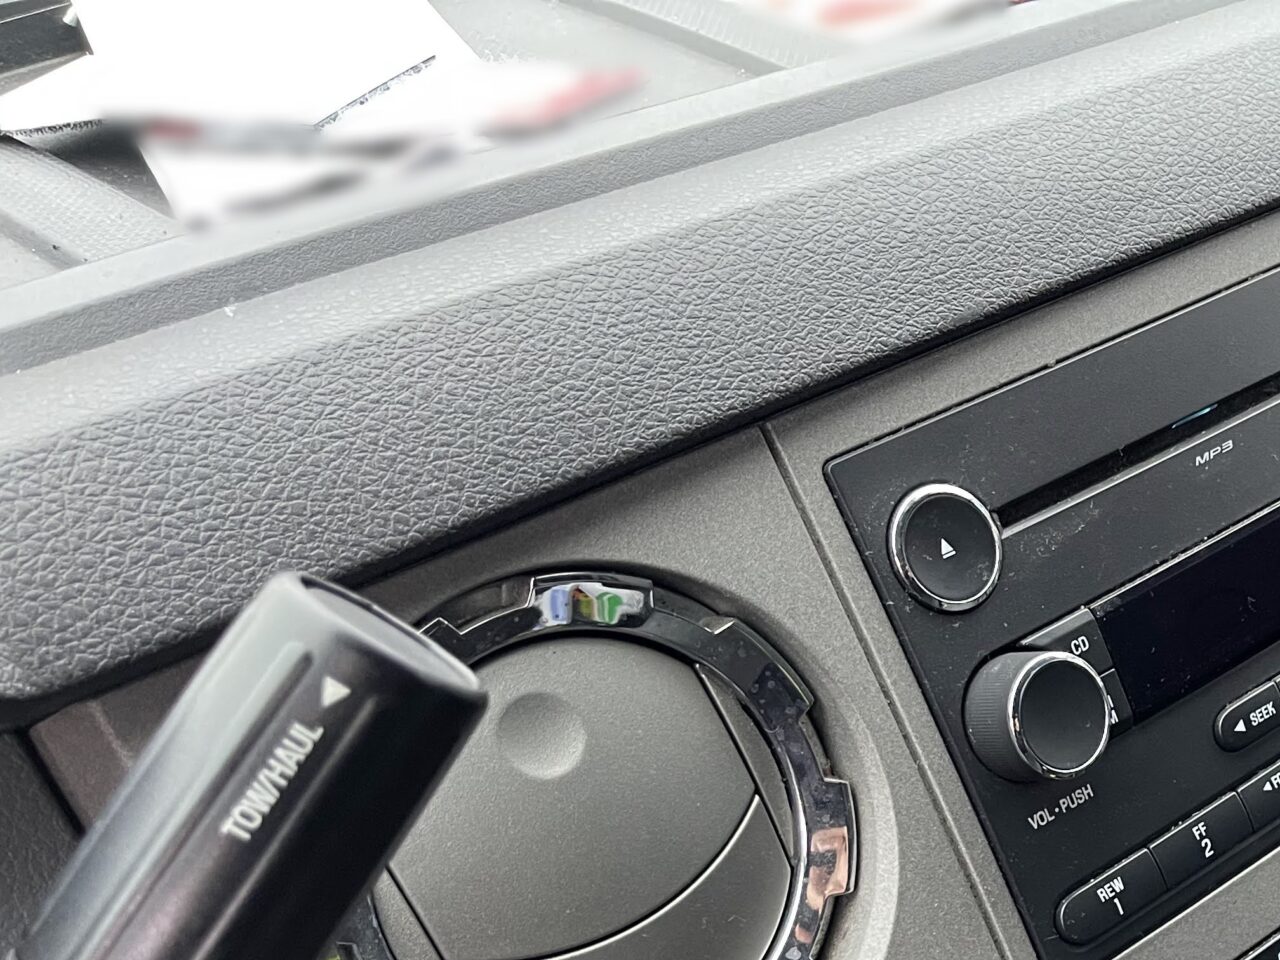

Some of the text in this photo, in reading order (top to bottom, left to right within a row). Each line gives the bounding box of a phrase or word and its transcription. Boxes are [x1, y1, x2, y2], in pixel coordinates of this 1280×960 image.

[1195, 440, 1233, 466] MP3
[1070, 635, 1089, 655] CD
[1250, 701, 1276, 727] SEEK
[220, 721, 324, 842] TOW/HAUL
[1059, 784, 1094, 813] PUSH
[1191, 821, 1207, 841] FF
[1201, 838, 1215, 858] 2
[1096, 876, 1125, 903] REW
[1113, 897, 1124, 916] 1
